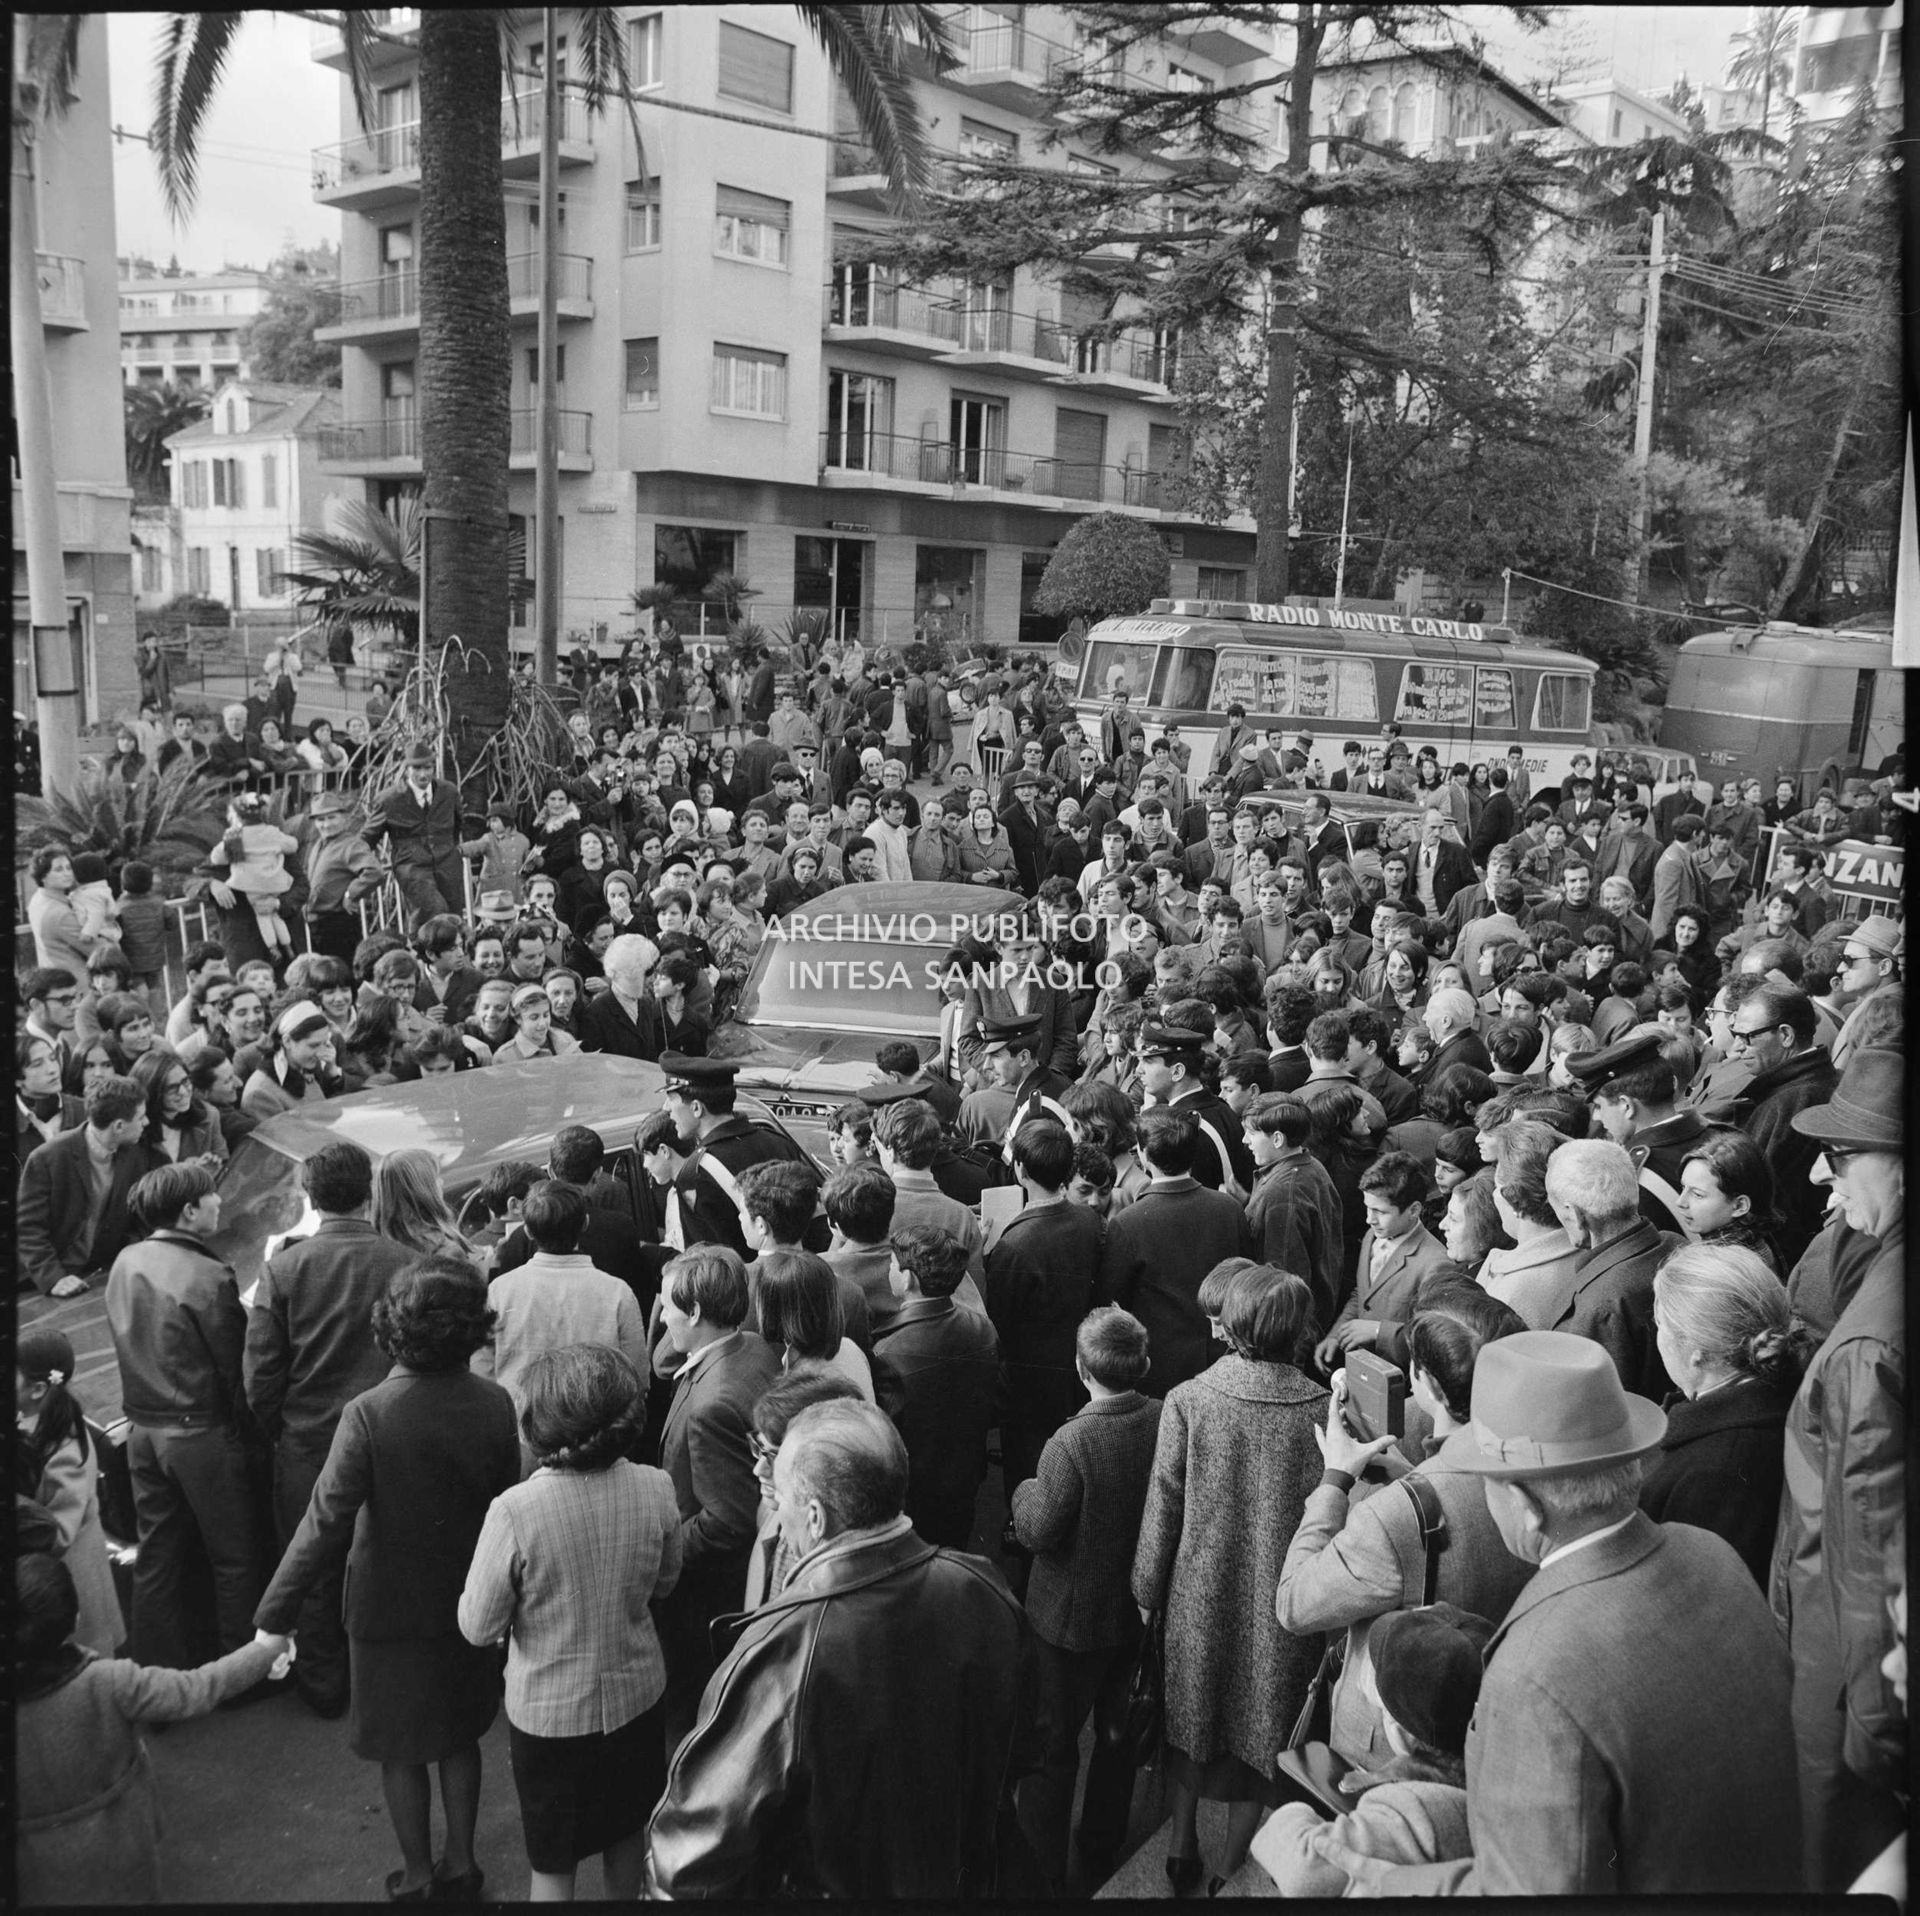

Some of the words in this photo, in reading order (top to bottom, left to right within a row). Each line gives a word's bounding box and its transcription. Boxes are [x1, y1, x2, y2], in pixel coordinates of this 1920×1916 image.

[1249, 603, 1320, 627] RADIO
[1328, 609, 1404, 634] MONTE
[1411, 616, 1483, 641] CARLO
